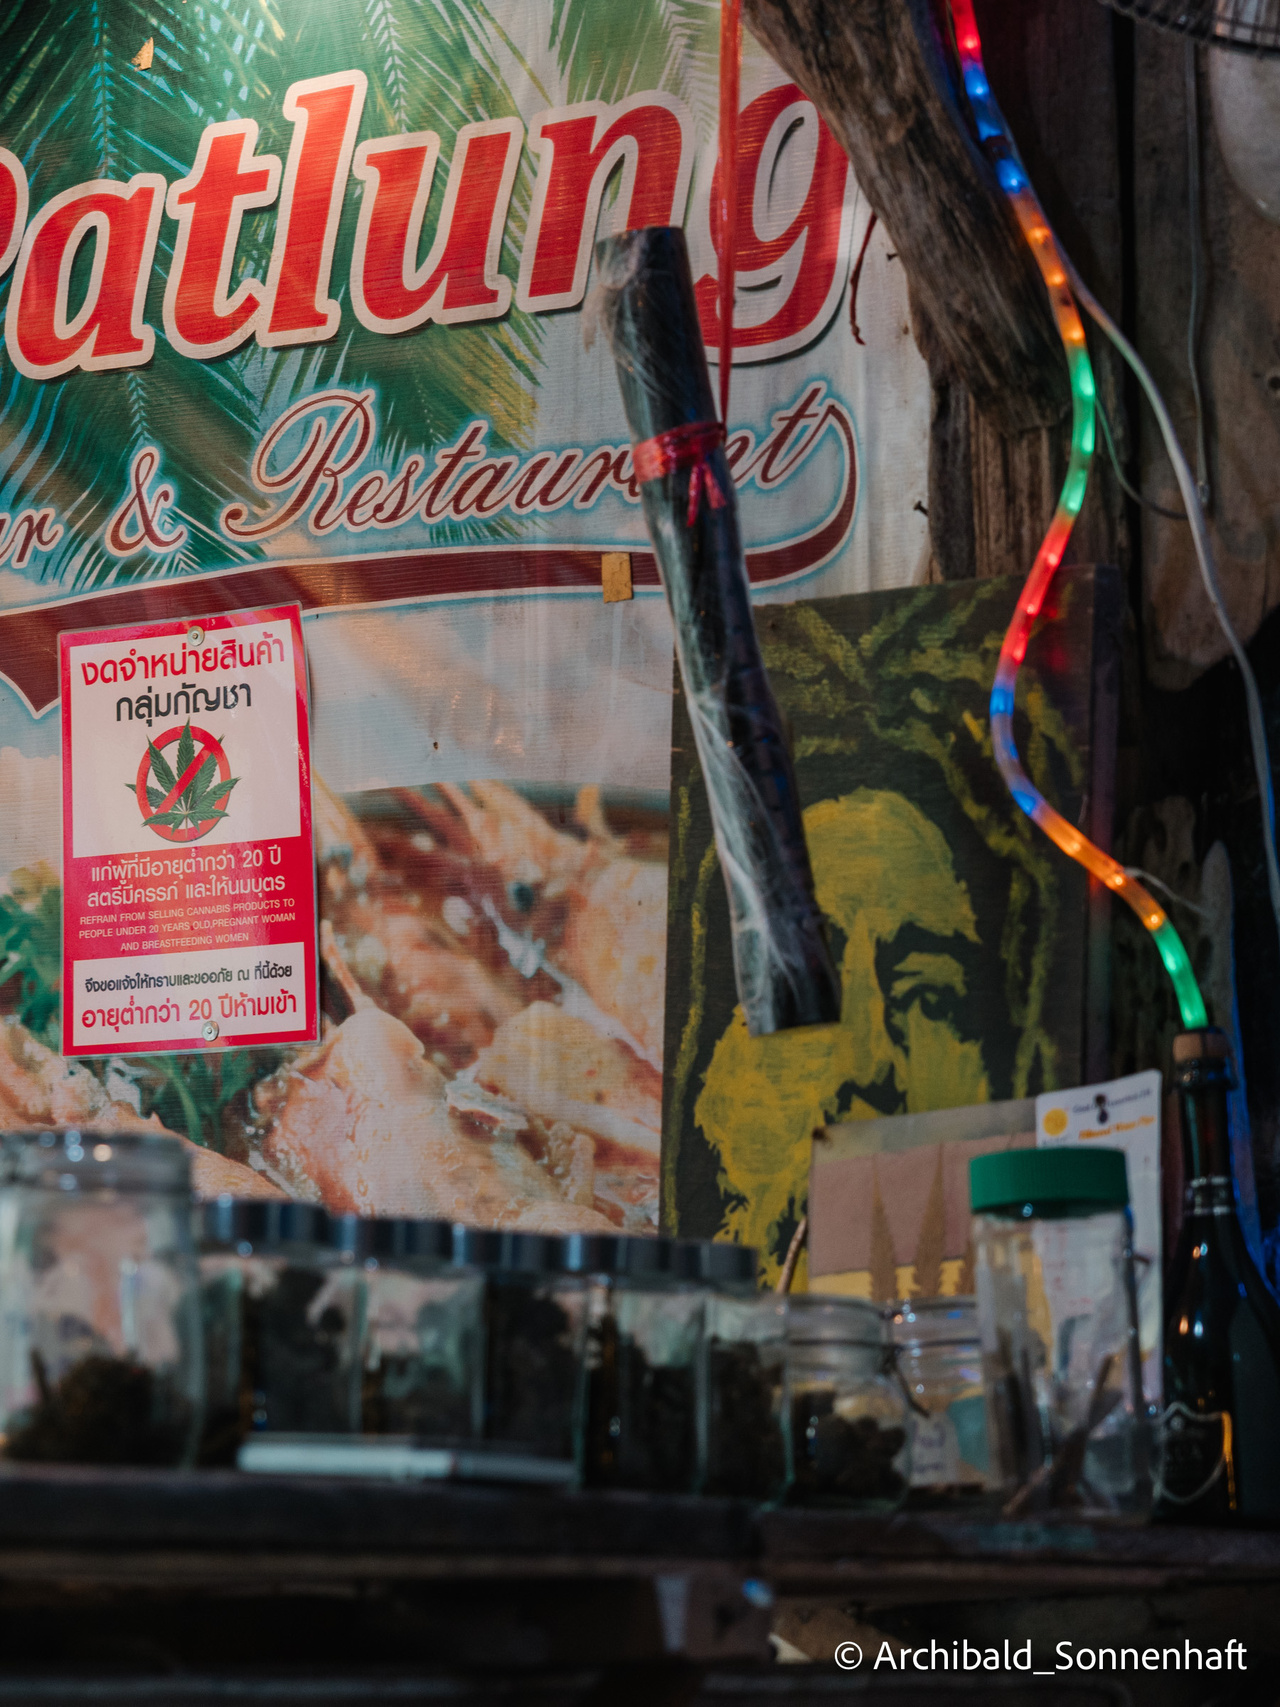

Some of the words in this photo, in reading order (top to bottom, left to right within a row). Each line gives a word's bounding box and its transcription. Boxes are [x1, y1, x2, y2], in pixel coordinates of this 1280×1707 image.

[105, 446, 187, 556] &
[222, 386, 832, 538] Restaurt
[81, 631, 285, 686] งดจำหน่ายสินค้า
[116, 682, 252, 728] กลุ่มกัญชา
[91, 848, 236, 885] แก่ผู้ที่มีอายุต่ำกว่า
[242, 849, 263, 868] 20
[268, 844, 281, 865] ปี
[87, 880, 178, 907] สตรีมีครรภ์
[186, 875, 286, 899] และให้นมบุตร
[79, 927, 114, 939] PEOPLE
[116, 925, 147, 936] UNDER
[148, 923, 159, 934] 20
[161, 921, 190, 932] YEARS
[192, 915, 259, 930] OLD,PREGNANT
[261, 912, 296, 924] WOMAN
[80, 913, 118, 925] REFRAIN
[120, 911, 146, 922] FROM
[148, 908, 184, 920] SELLING
[186, 904, 231, 916] CANNABIS
[233, 899, 280, 912] PRODUCTS
[282, 898, 295, 909] TO
[120, 941, 140, 951] AND
[142, 935, 213, 950] BREASTFEEDING
[215, 933, 249, 944] WOMEN
[84, 968, 233, 993] จึงขอแจ้งให้ทราบและขออภัย
[237, 968, 250, 982] ณ
[81, 995, 181, 1033] อายุต่ำกว่า
[188, 998, 213, 1021] 20
[218, 988, 297, 1018] ปีห้ามเข้า
